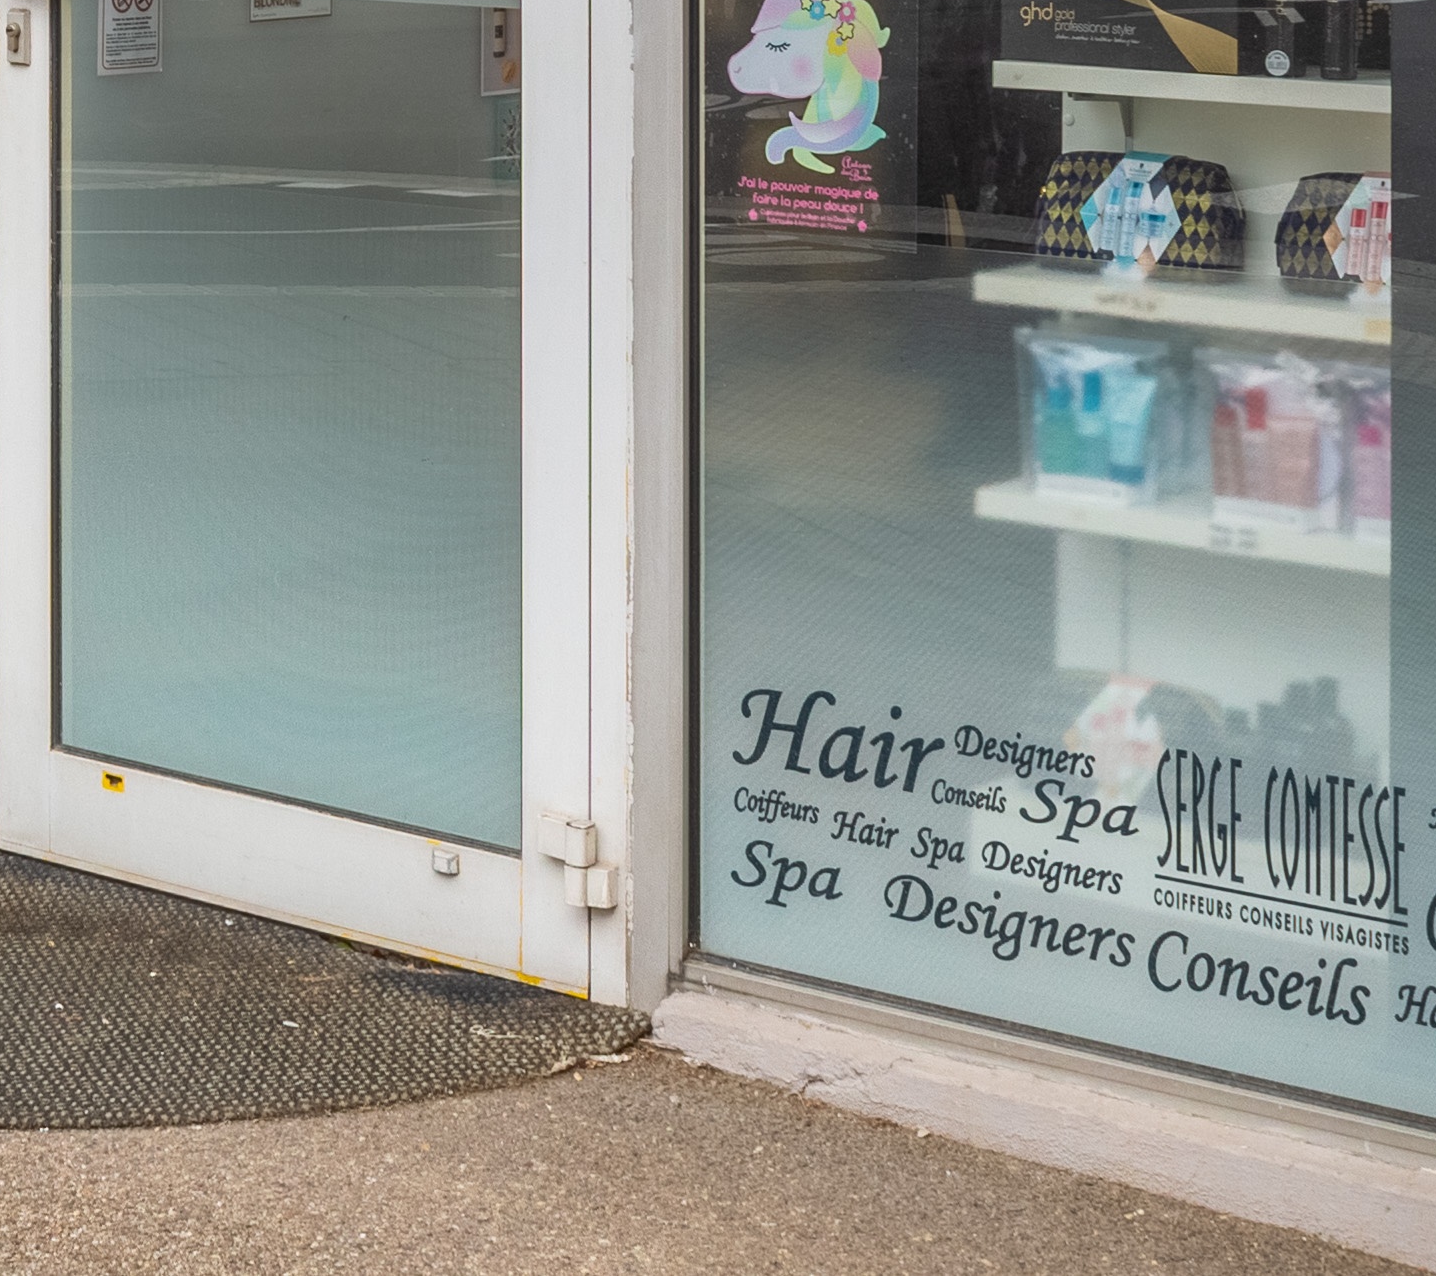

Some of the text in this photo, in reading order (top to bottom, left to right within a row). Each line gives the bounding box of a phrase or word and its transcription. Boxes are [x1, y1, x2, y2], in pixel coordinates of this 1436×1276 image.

[1020, 1, 1054, 26] ghd
[1054, 20, 1137, 36] professional styler
[752, 192, 779, 206] faire
[780, 194, 791, 207] la
[793, 198, 821, 210] peau
[823, 200, 858, 214] douce
[758, 177, 768, 189] le
[770, 180, 812, 193] pouvoir
[814, 184, 861, 199] magique
[864, 189, 879, 200] de
[732, 689, 945, 793] Hair
[954, 724, 1096, 779] Designers
[734, 787, 1123, 894] Coiffeurs Hair Spa Designers
[931, 778, 1140, 843] Conseils Spa
[1156, 748, 1409, 916] SERGE COMTESSE
[731, 839, 843, 908] Spa
[883, 874, 1136, 968] Designers
[1147, 930, 1370, 1026] Conseils
[1153, 887, 1411, 955] COIFFEURS CONSEILS VISAGISTES
